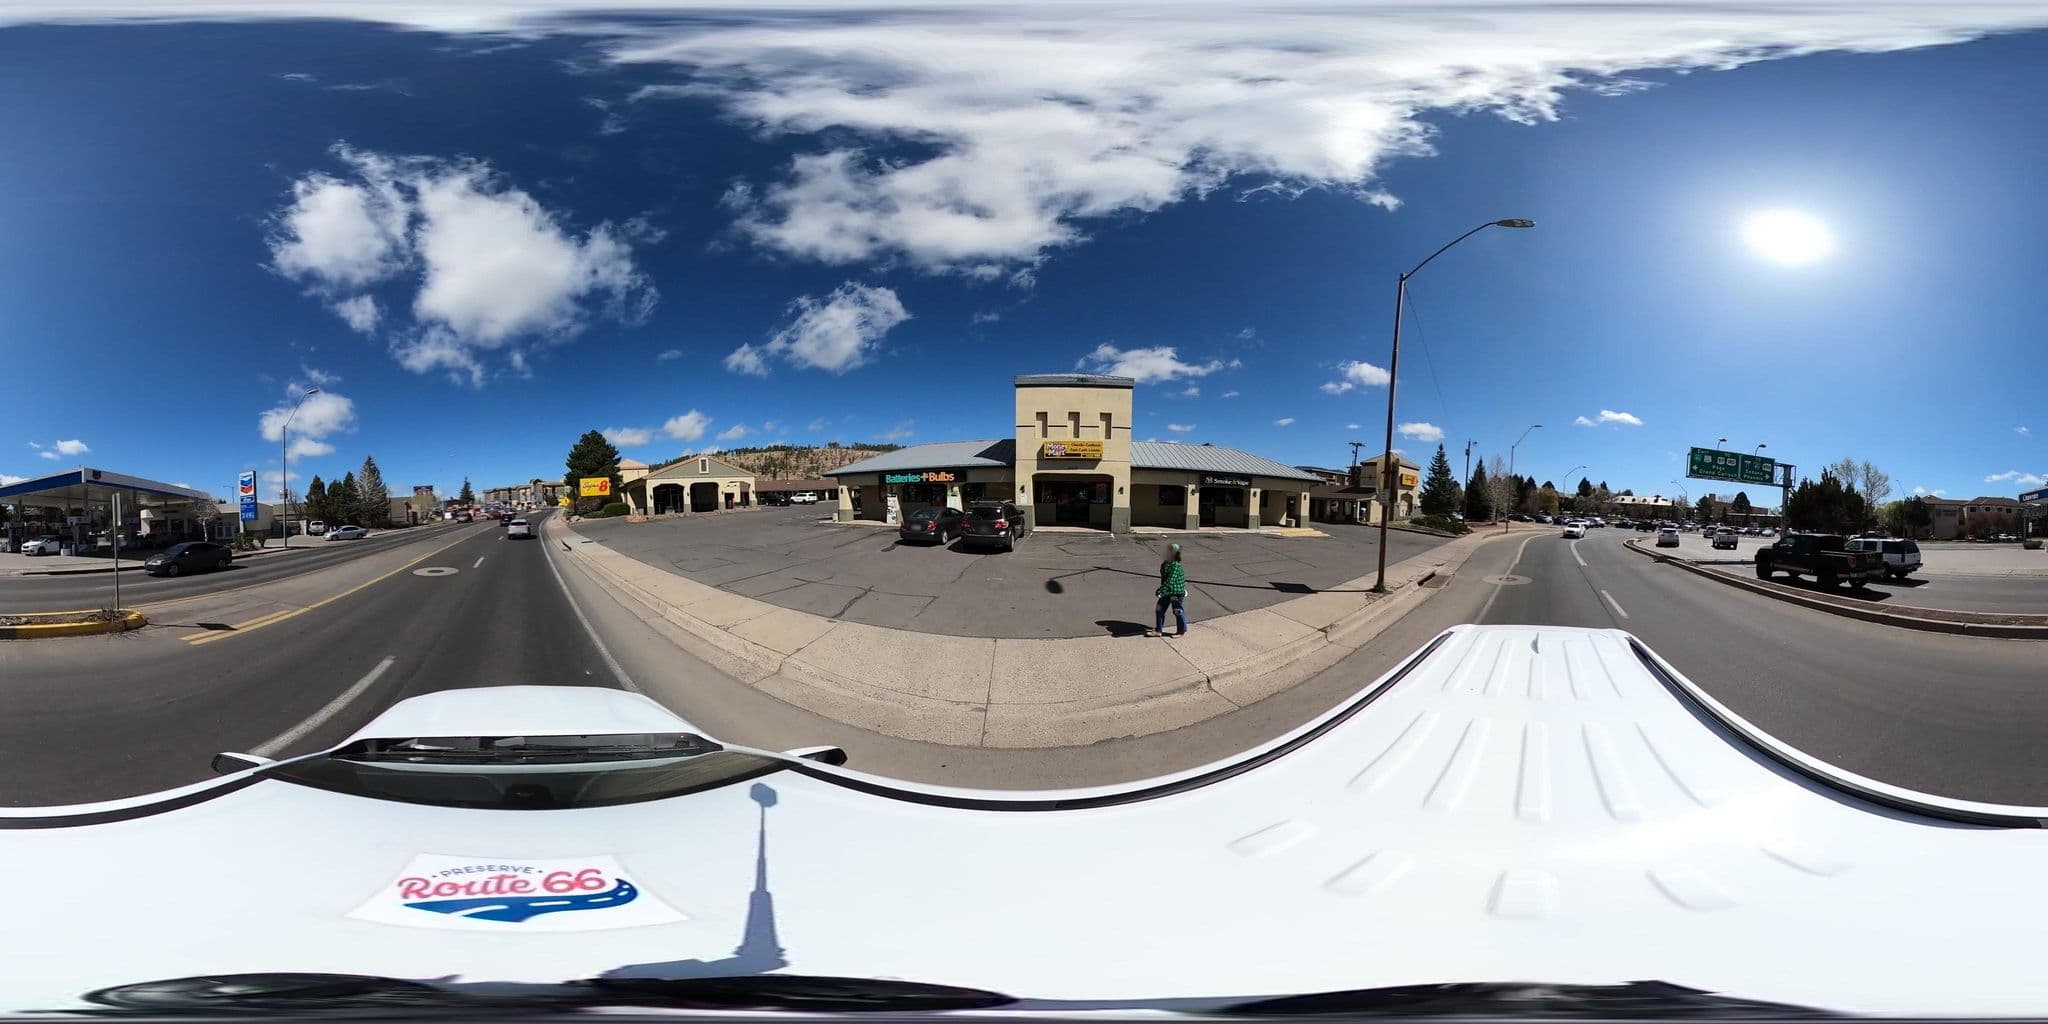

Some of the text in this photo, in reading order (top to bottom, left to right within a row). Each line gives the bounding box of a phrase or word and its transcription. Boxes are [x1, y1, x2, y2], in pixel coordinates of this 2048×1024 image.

[599, 480, 608, 492] 8
[440, 864, 535, 877] PRESERVE
[398, 868, 607, 899] Route 66
